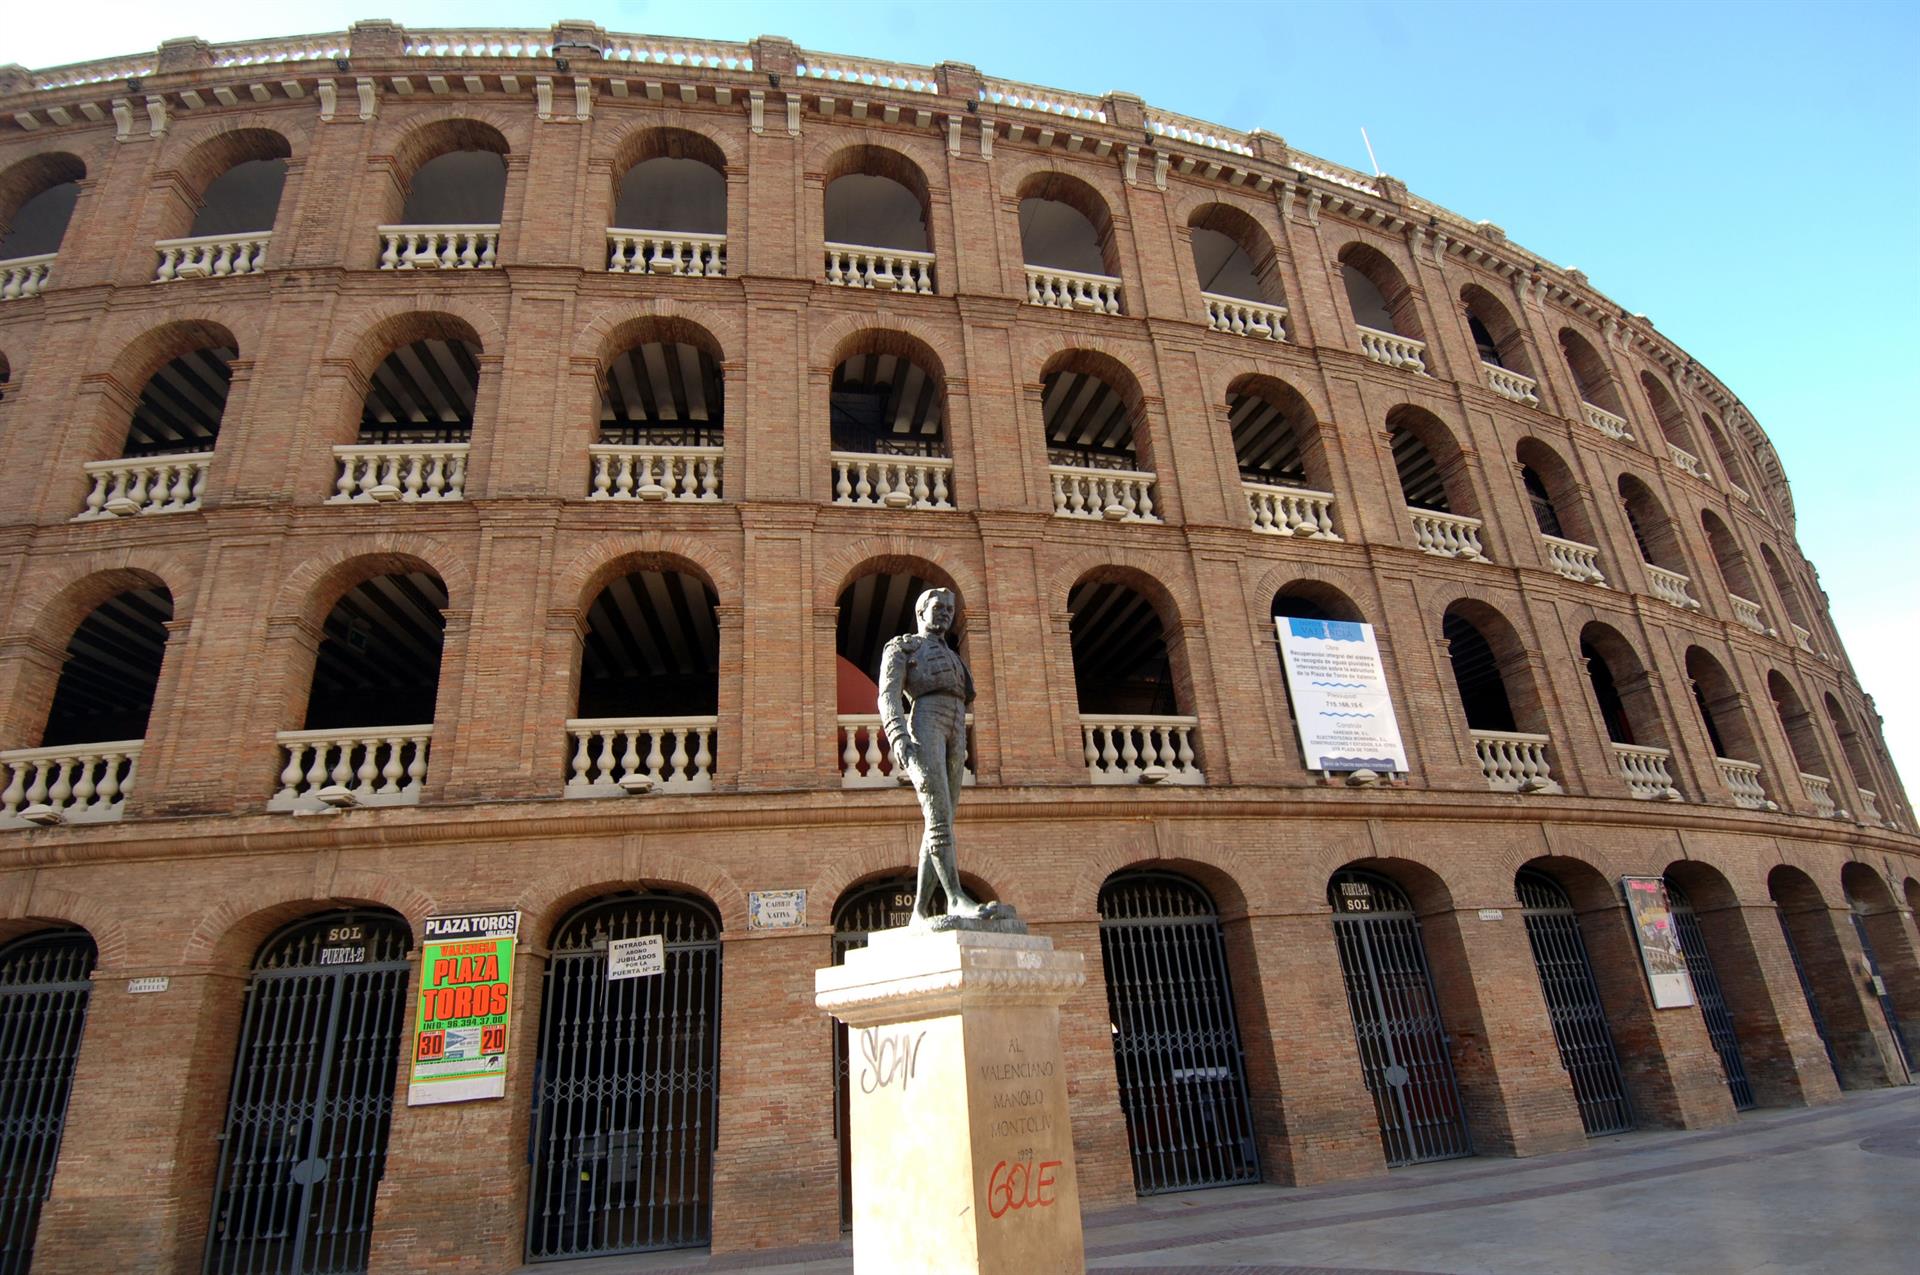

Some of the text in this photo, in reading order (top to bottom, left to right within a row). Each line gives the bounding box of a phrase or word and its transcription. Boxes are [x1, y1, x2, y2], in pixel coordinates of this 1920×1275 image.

[1347, 899, 1369, 910] SOL
[426, 915, 515, 935] PLAZA TOROS
[329, 927, 361, 941] SOL
[441, 942, 497, 956] VALENCIA
[614, 940, 647, 950] ENTRADA
[626, 948, 647, 956] ABONO
[616, 953, 656, 964] JUBILADOS
[433, 955, 499, 986] PLAZA
[612, 968, 640, 977] PUERTA
[423, 983, 508, 1022] TOROS
[421, 1034, 442, 1056] 30
[483, 1029, 503, 1050] 20
[1008, 1039, 1024, 1054] AL
[981, 1061, 1054, 1081] VALENCIANO
[993, 1089, 1045, 1109] MANOLO
